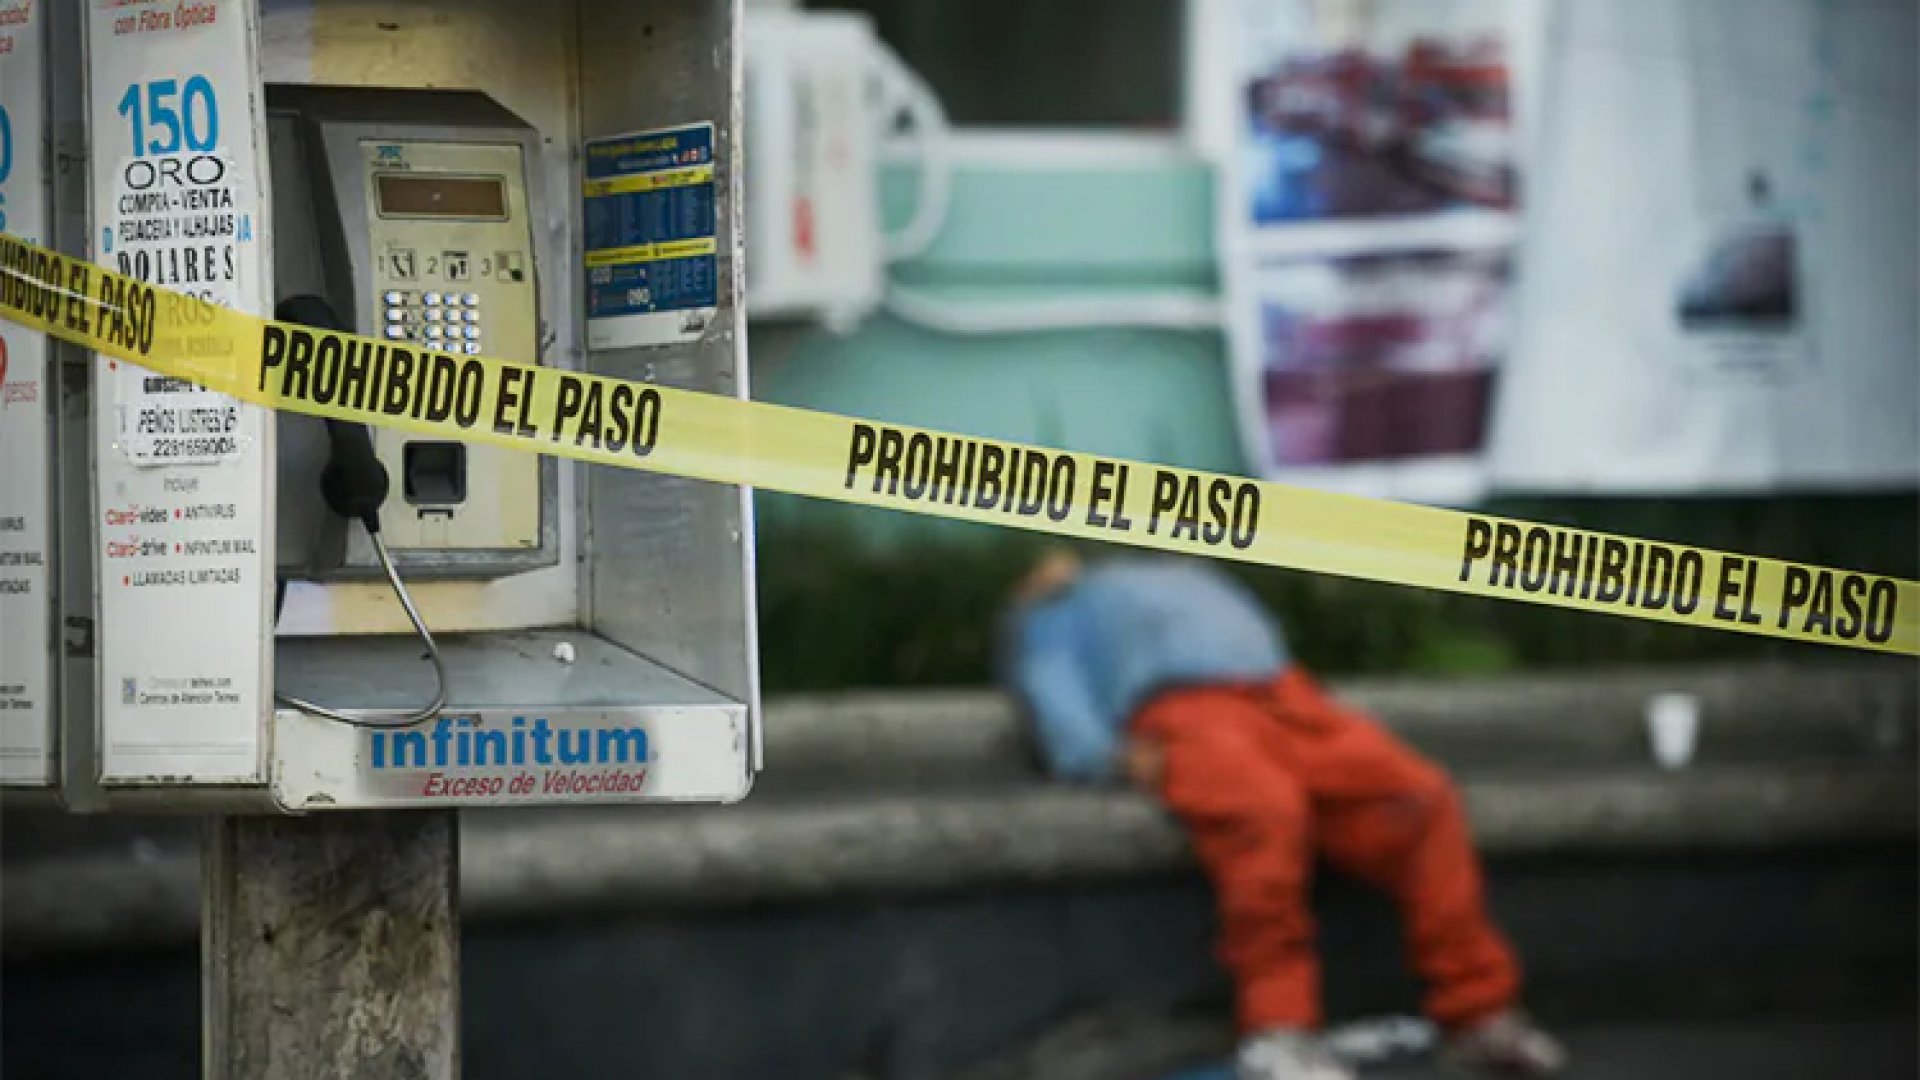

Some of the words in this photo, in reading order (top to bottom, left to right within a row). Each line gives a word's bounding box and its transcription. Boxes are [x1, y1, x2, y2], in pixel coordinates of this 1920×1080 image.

[118, 74, 219, 157] 150
[125, 156, 224, 189] ORO
[97, 273, 156, 356] PASO
[259, 325, 484, 428] PROHIBIDO
[493, 366, 536, 438] EL
[553, 376, 662, 457] PASO
[844, 424, 1076, 522] PROHIBIDO
[1085, 460, 1132, 531] EL
[1147, 470, 1260, 549] PASO
[1459, 518, 1703, 615] PROHIBIDO
[1712, 556, 1762, 625] EL
[1776, 565, 1898, 644] PASO
[370, 716, 649, 769] infinitum
[422, 772, 503, 797] Exceso
[509, 772, 536, 794] de
[542, 767, 647, 793] Velocidad
